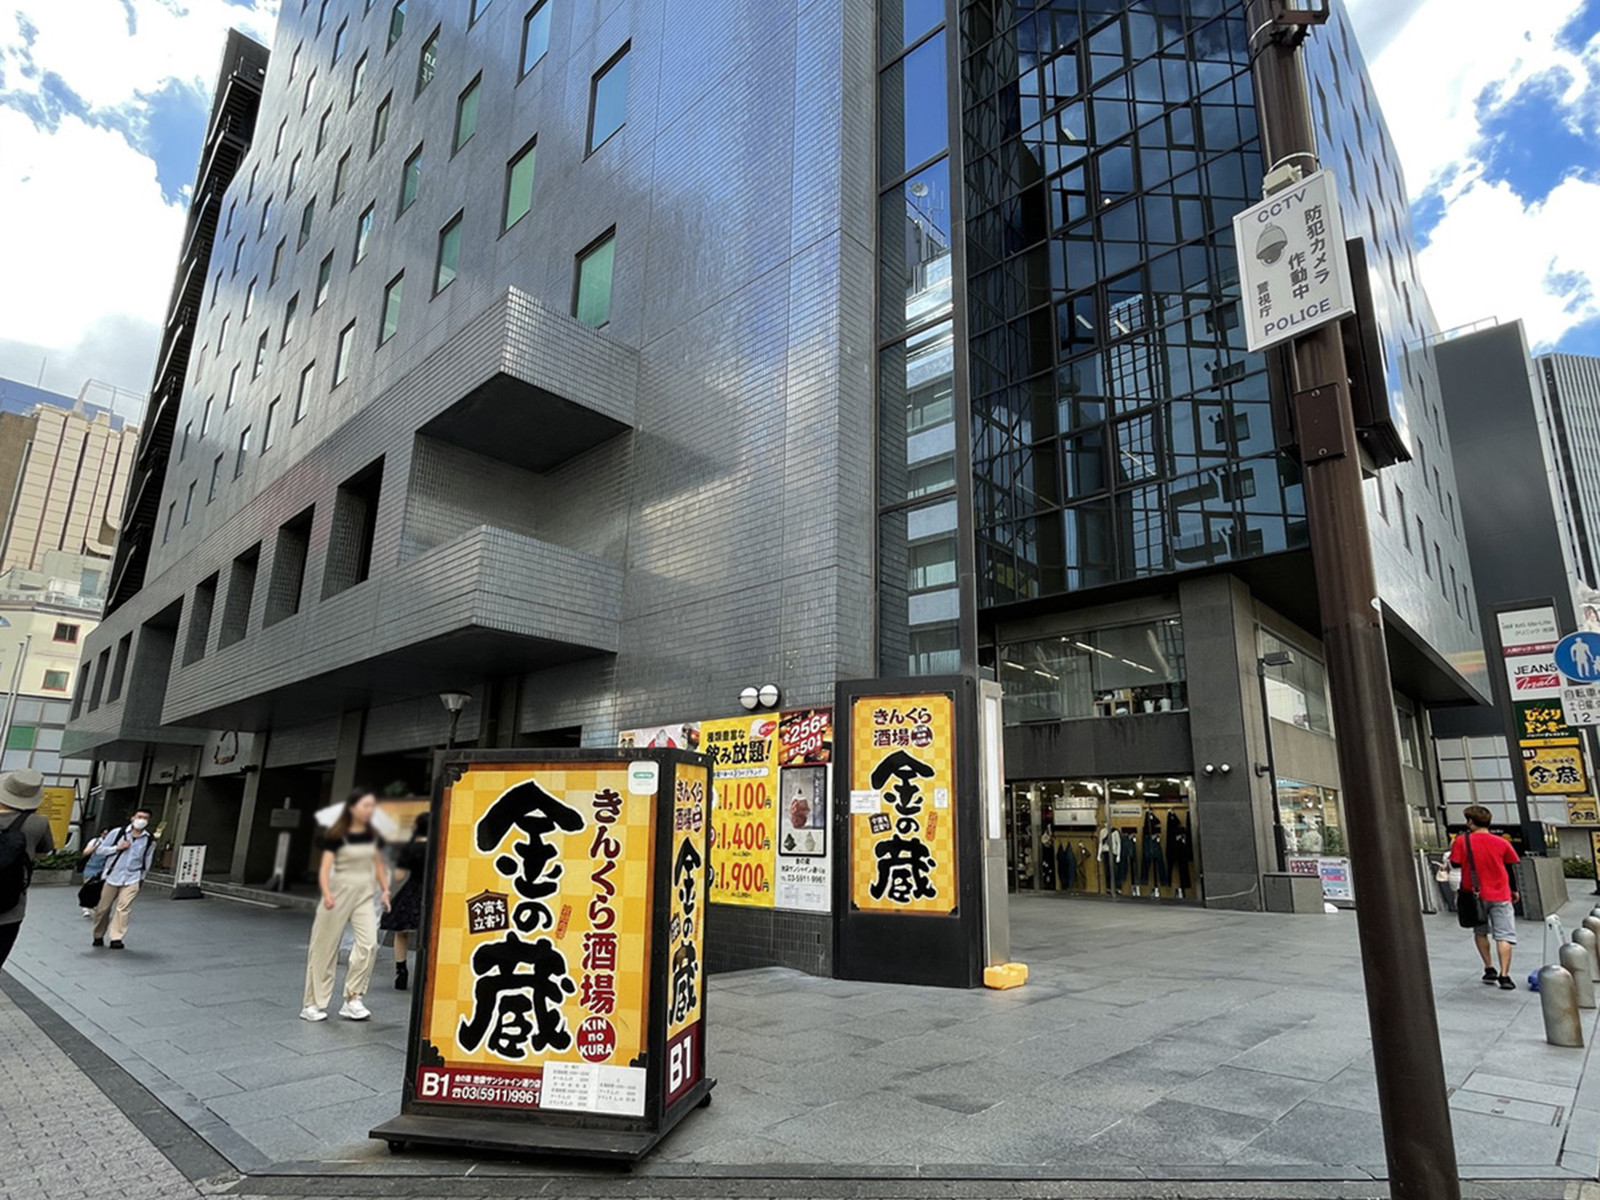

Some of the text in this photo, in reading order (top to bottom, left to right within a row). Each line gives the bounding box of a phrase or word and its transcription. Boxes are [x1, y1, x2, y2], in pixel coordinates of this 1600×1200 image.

[1258, 189, 1306, 223] CCTV
[1304, 204, 1330, 284] 防犯カメラ
[1288, 251, 1310, 300] 作動中
[1257, 281, 1272, 319] 警視庁
[1264, 298, 1332, 336] POLICE
[1514, 663, 1558, 675] JEANS
[1564, 688, 1600, 700] 自転車
[873, 707, 933, 725] きんくら
[873, 728, 910, 747] 酒場
[676, 779, 704, 803] きんくら
[870, 750, 937, 903] 金の蔵
[580, 789, 622, 1014] きんくら酒場
[459, 780, 585, 1057] 金の蔵
[474, 913, 506, 931] 立寄り
[669, 837, 702, 1025] 金の蔵
[582, 1019, 607, 1031] KIN
[588, 1032, 605, 1041] no
[579, 1043, 614, 1057] KURA
[669, 1035, 692, 1094] B1
[422, 1072, 449, 1097] B1
[461, 1086, 540, 1105] 03(5911)9961
